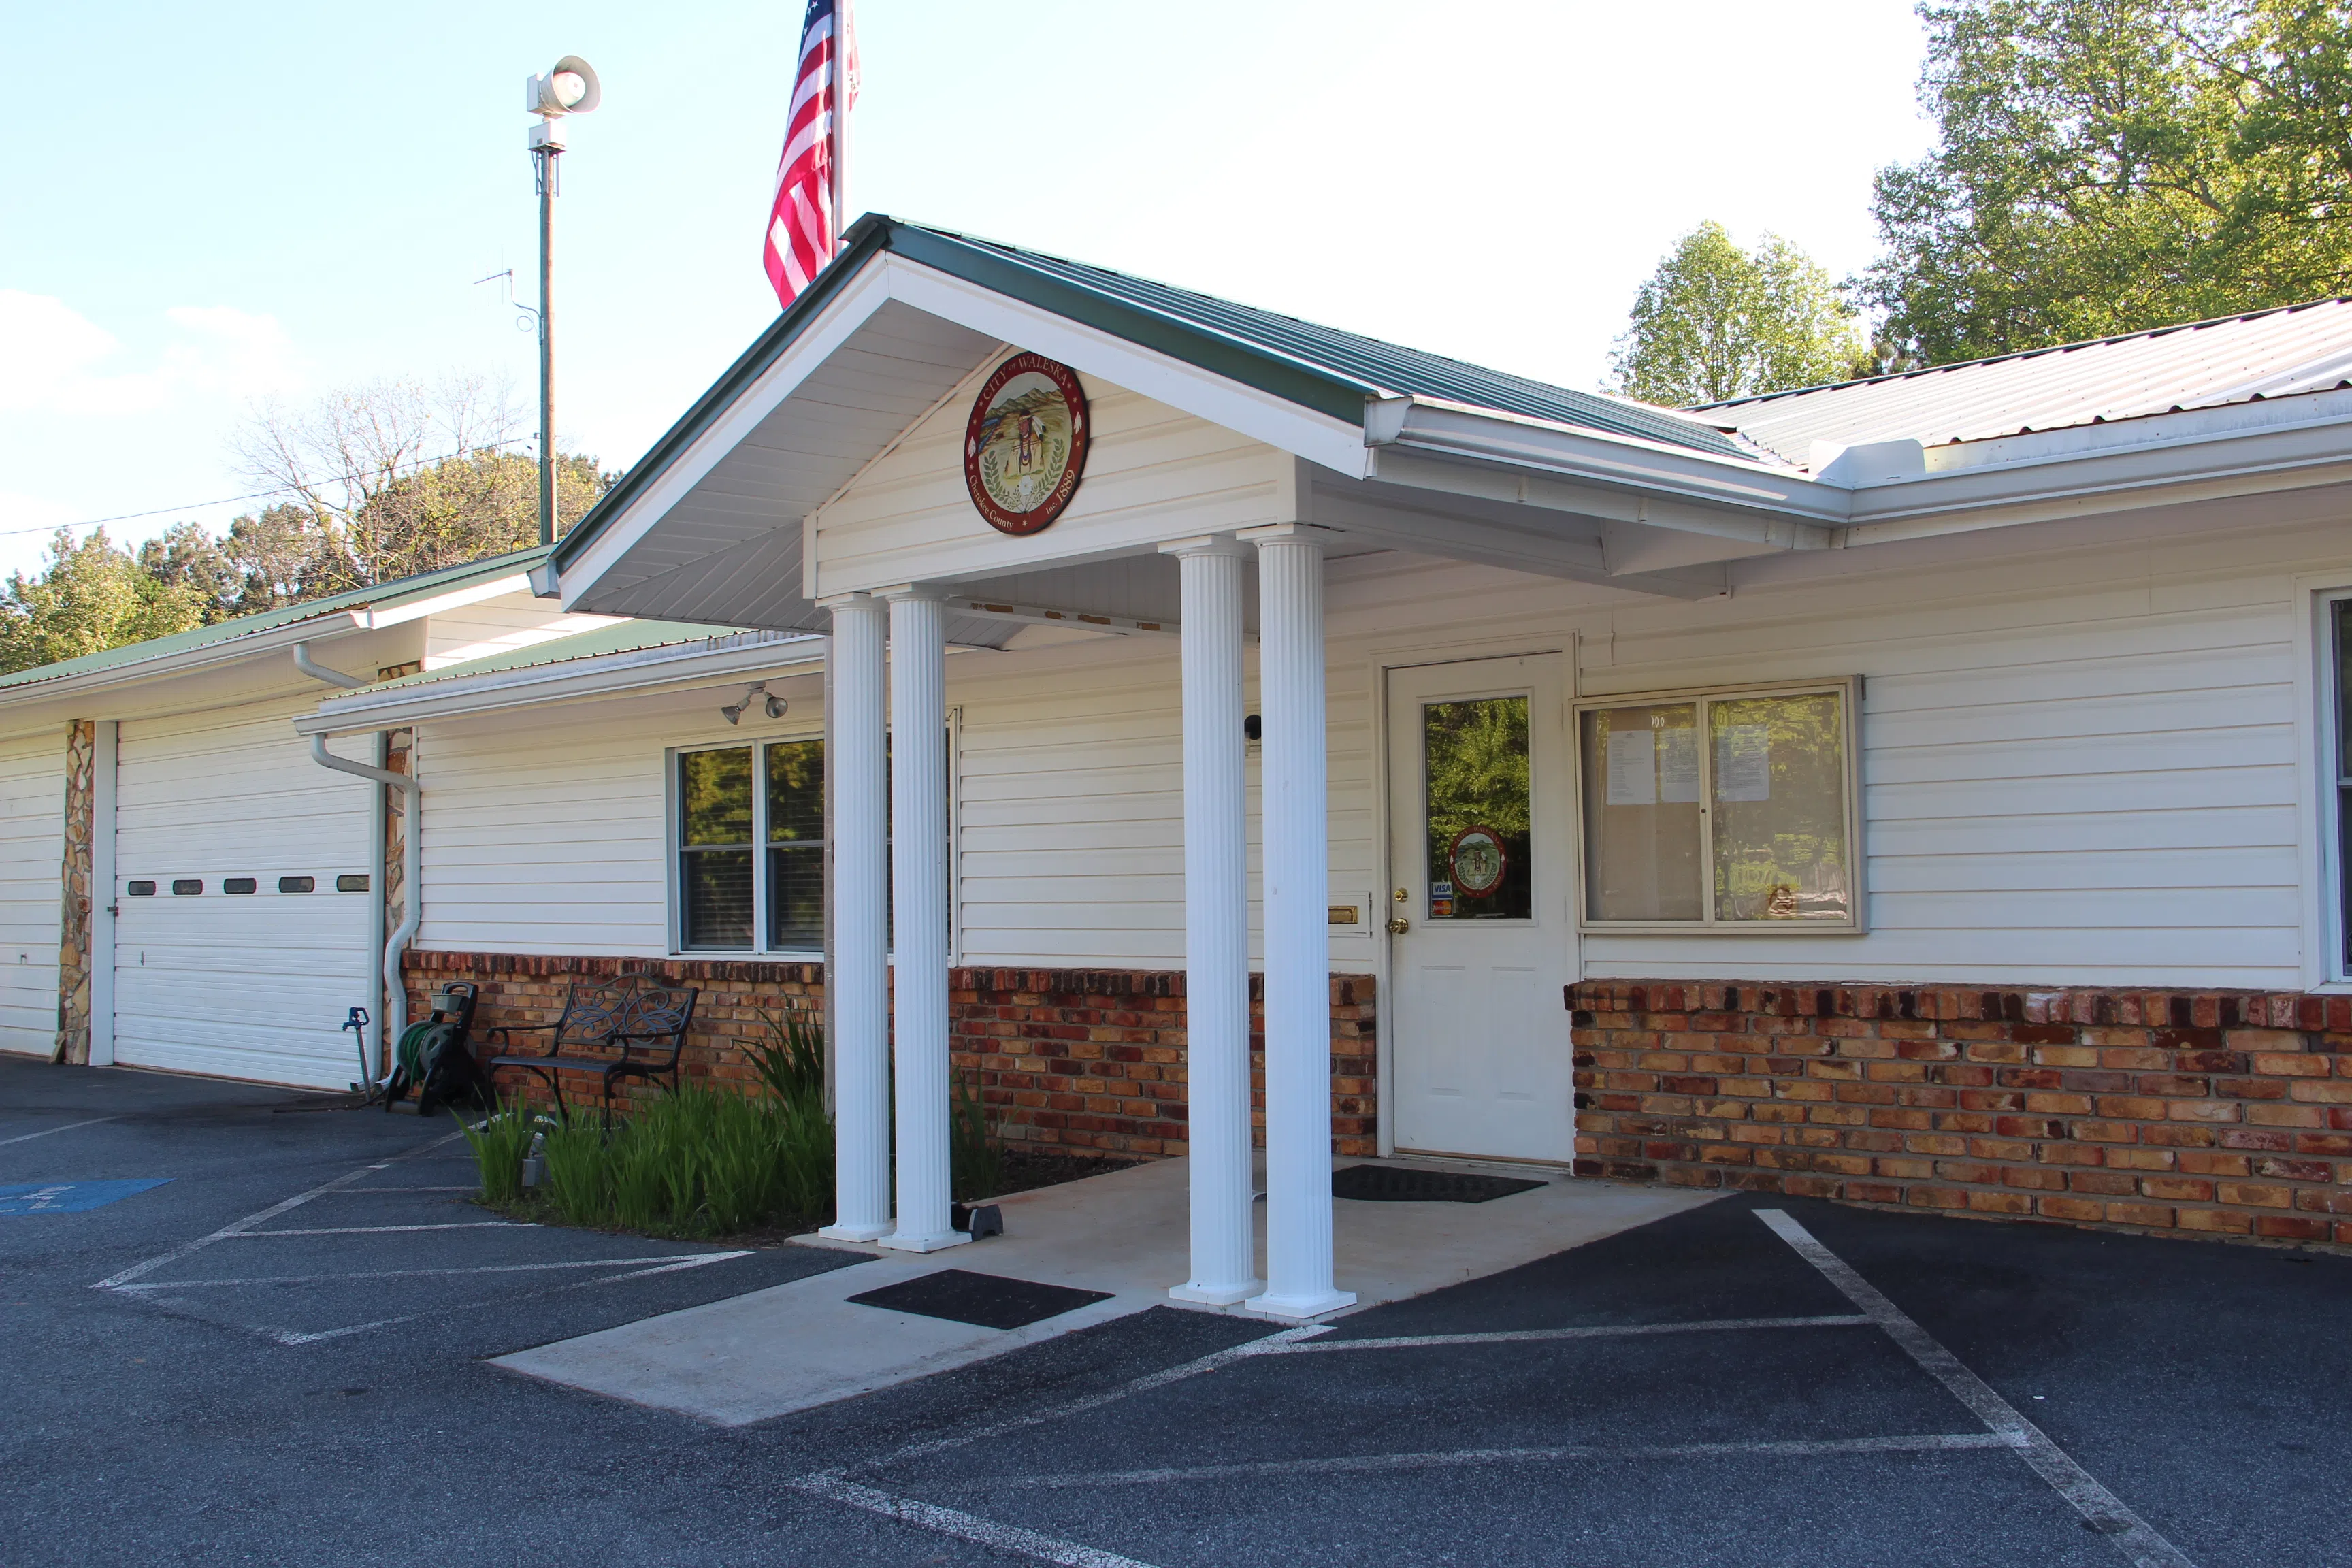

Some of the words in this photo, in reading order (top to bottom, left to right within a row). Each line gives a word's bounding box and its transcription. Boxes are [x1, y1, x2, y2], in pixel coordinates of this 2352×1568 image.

[983, 367, 1007, 400] CITY
[1009, 363, 1017, 371] OF
[1019, 355, 1068, 386] WALESKA
[970, 475, 990, 514] Cherokee
[990, 510, 1014, 530] County
[1045, 502, 1058, 514] Inc.
[1056, 470, 1075, 503] 1889
